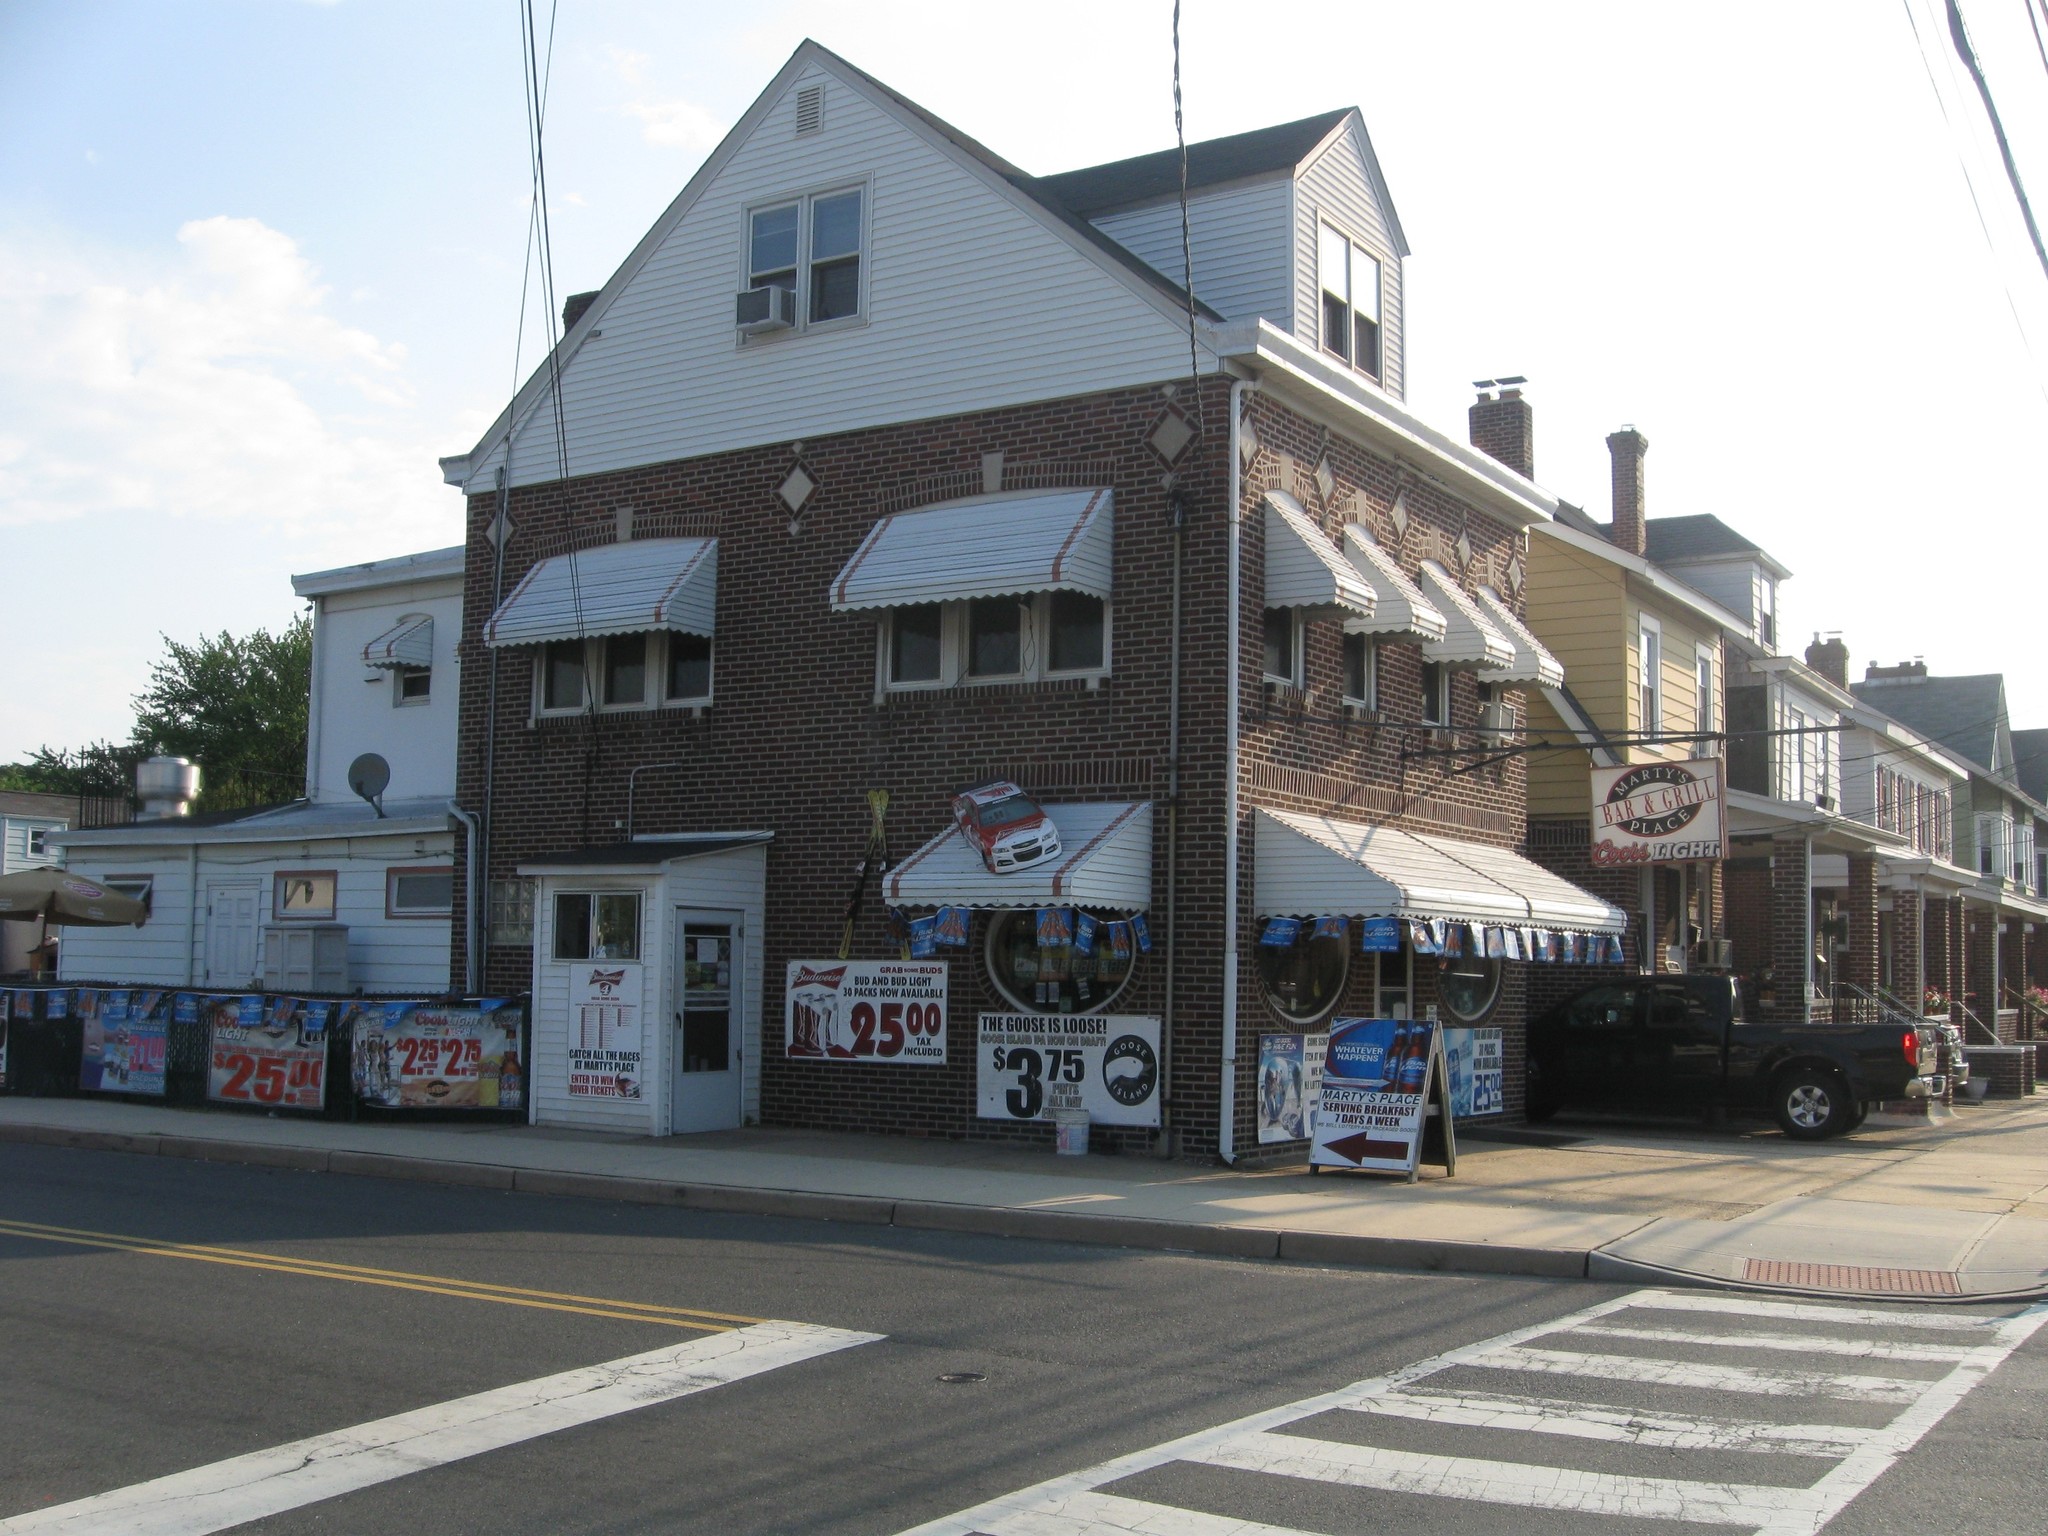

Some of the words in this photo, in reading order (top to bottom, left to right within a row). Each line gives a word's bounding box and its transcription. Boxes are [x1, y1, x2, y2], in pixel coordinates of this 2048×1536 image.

[1614, 767, 1689, 796] MARTY'S
[1602, 799, 1635, 825] BAR
[1644, 793, 1655, 814] &
[1662, 779, 1715, 810] GRILL
[1630, 808, 1690, 834] PLACE
[1592, 838, 1651, 864] Coors
[1652, 841, 1720, 862] LIGHT
[794, 970, 846, 984] Budweiser
[880, 966, 904, 974] GRAB
[919, 967, 943, 975] BUDS
[854, 976, 870, 986] BUD
[872, 976, 889, 986] AND
[891, 976, 907, 986] BUD
[909, 977, 932, 987] LIGHT
[600, 984, 610, 996] 4
[843, 987, 853, 998] 30
[854, 988, 878, 998] PACKS
[879, 988, 899, 999] NOW
[900, 988, 943, 999] AVAILABLE
[415, 1011, 449, 1026] Coors
[448, 1014, 481, 1027] LIGHT
[981, 1016, 1004, 1032] THE
[1006, 1016, 1045, 1033] GOOSE
[1048, 1017, 1061, 1033] IS
[1063, 1018, 1107, 1035] LOOSE!
[216, 1028, 250, 1041] LIGHT
[1046, 1036, 1065, 1046] NOW
[916, 1037, 931, 1046] TAX
[569, 1049, 591, 1059] CATCH
[593, 1050, 605, 1060] ALL
[606, 1051, 618, 1061] THE
[618, 1051, 641, 1062] RACES
[904, 1047, 943, 1057] INCLUDED
[1113, 1041, 1148, 1058] GOOSE
[1334, 1045, 1384, 1055] WHATEVER
[1337, 1054, 1379, 1063] HAPPENS
[574, 1060, 583, 1069] AT
[584, 1060, 613, 1072] MARTY'S
[614, 1062, 635, 1073] PLACE
[571, 1074, 590, 1084] ENTER
[591, 1075, 600, 1085] TO
[600, 1076, 614, 1086] WIN
[569, 1084, 589, 1095] DOVER
[590, 1085, 616, 1097] TICKETS
[1052, 1083, 1080, 1095] PINTS
[1112, 1083, 1149, 1101] ISLAND
[1048, 1097, 1064, 1108] ALL
[1321, 1090, 1377, 1103] MARTY'S
[1379, 1094, 1421, 1105] PLACE
[1322, 1102, 1362, 1114] SERVING
[1364, 1105, 1416, 1117] BREAKFAST
[1335, 1113, 1340, 1123] 7
[1341, 1114, 1365, 1125] DAYS
[1366, 1116, 1374, 1126] A
[1375, 1116, 1401, 1127] WEEK
